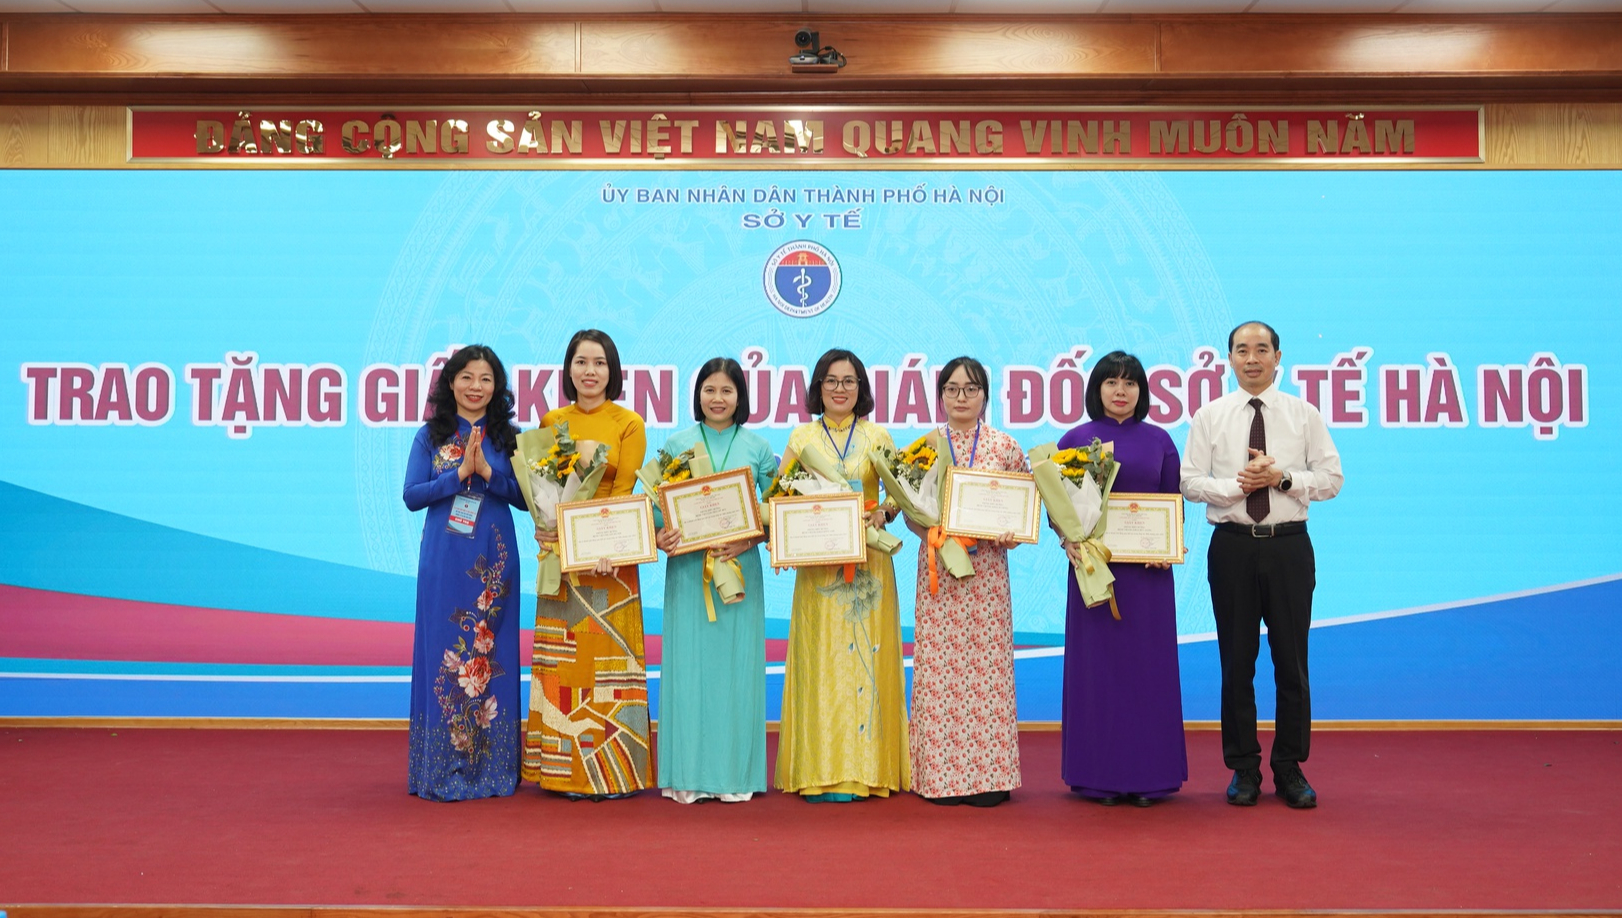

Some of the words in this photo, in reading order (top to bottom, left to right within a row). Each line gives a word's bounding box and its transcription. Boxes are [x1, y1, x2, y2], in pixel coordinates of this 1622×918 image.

[194, 111, 326, 154] ĐẢNG
[341, 113, 470, 159] CỘNG
[485, 111, 583, 154] SẢN
[599, 114, 699, 159] VIỆT
[715, 119, 824, 154] NAM
[842, 119, 1003, 157] QUANG
[1020, 119, 1131, 154] VINH
[1149, 113, 1289, 154] MUÔN
[1307, 112, 1415, 154] NĂM
[602, 183, 629, 203] ỦY
[637, 188, 679, 203] BAN
[687, 185, 745, 203] NHÂN
[753, 185, 797, 203] DÂN
[804, 185, 875, 203] THÀNH
[883, 183, 927, 203] PHỐ
[933, 185, 962, 203] HÀ
[969, 185, 1004, 206] NỘI
[743, 208, 785, 228] SỞ
[795, 214, 813, 228] Y
[823, 208, 861, 228] TẾ
[27, 367, 170, 422] TRAO
[191, 356, 342, 434] TẶNG
[1007, 350, 1087, 423] ĐỐ
[1148, 351, 1226, 423] SỞ
[1298, 351, 1368, 422] TẾ
[1385, 357, 1463, 422] HÀ
[1483, 357, 1584, 435] NỘI
